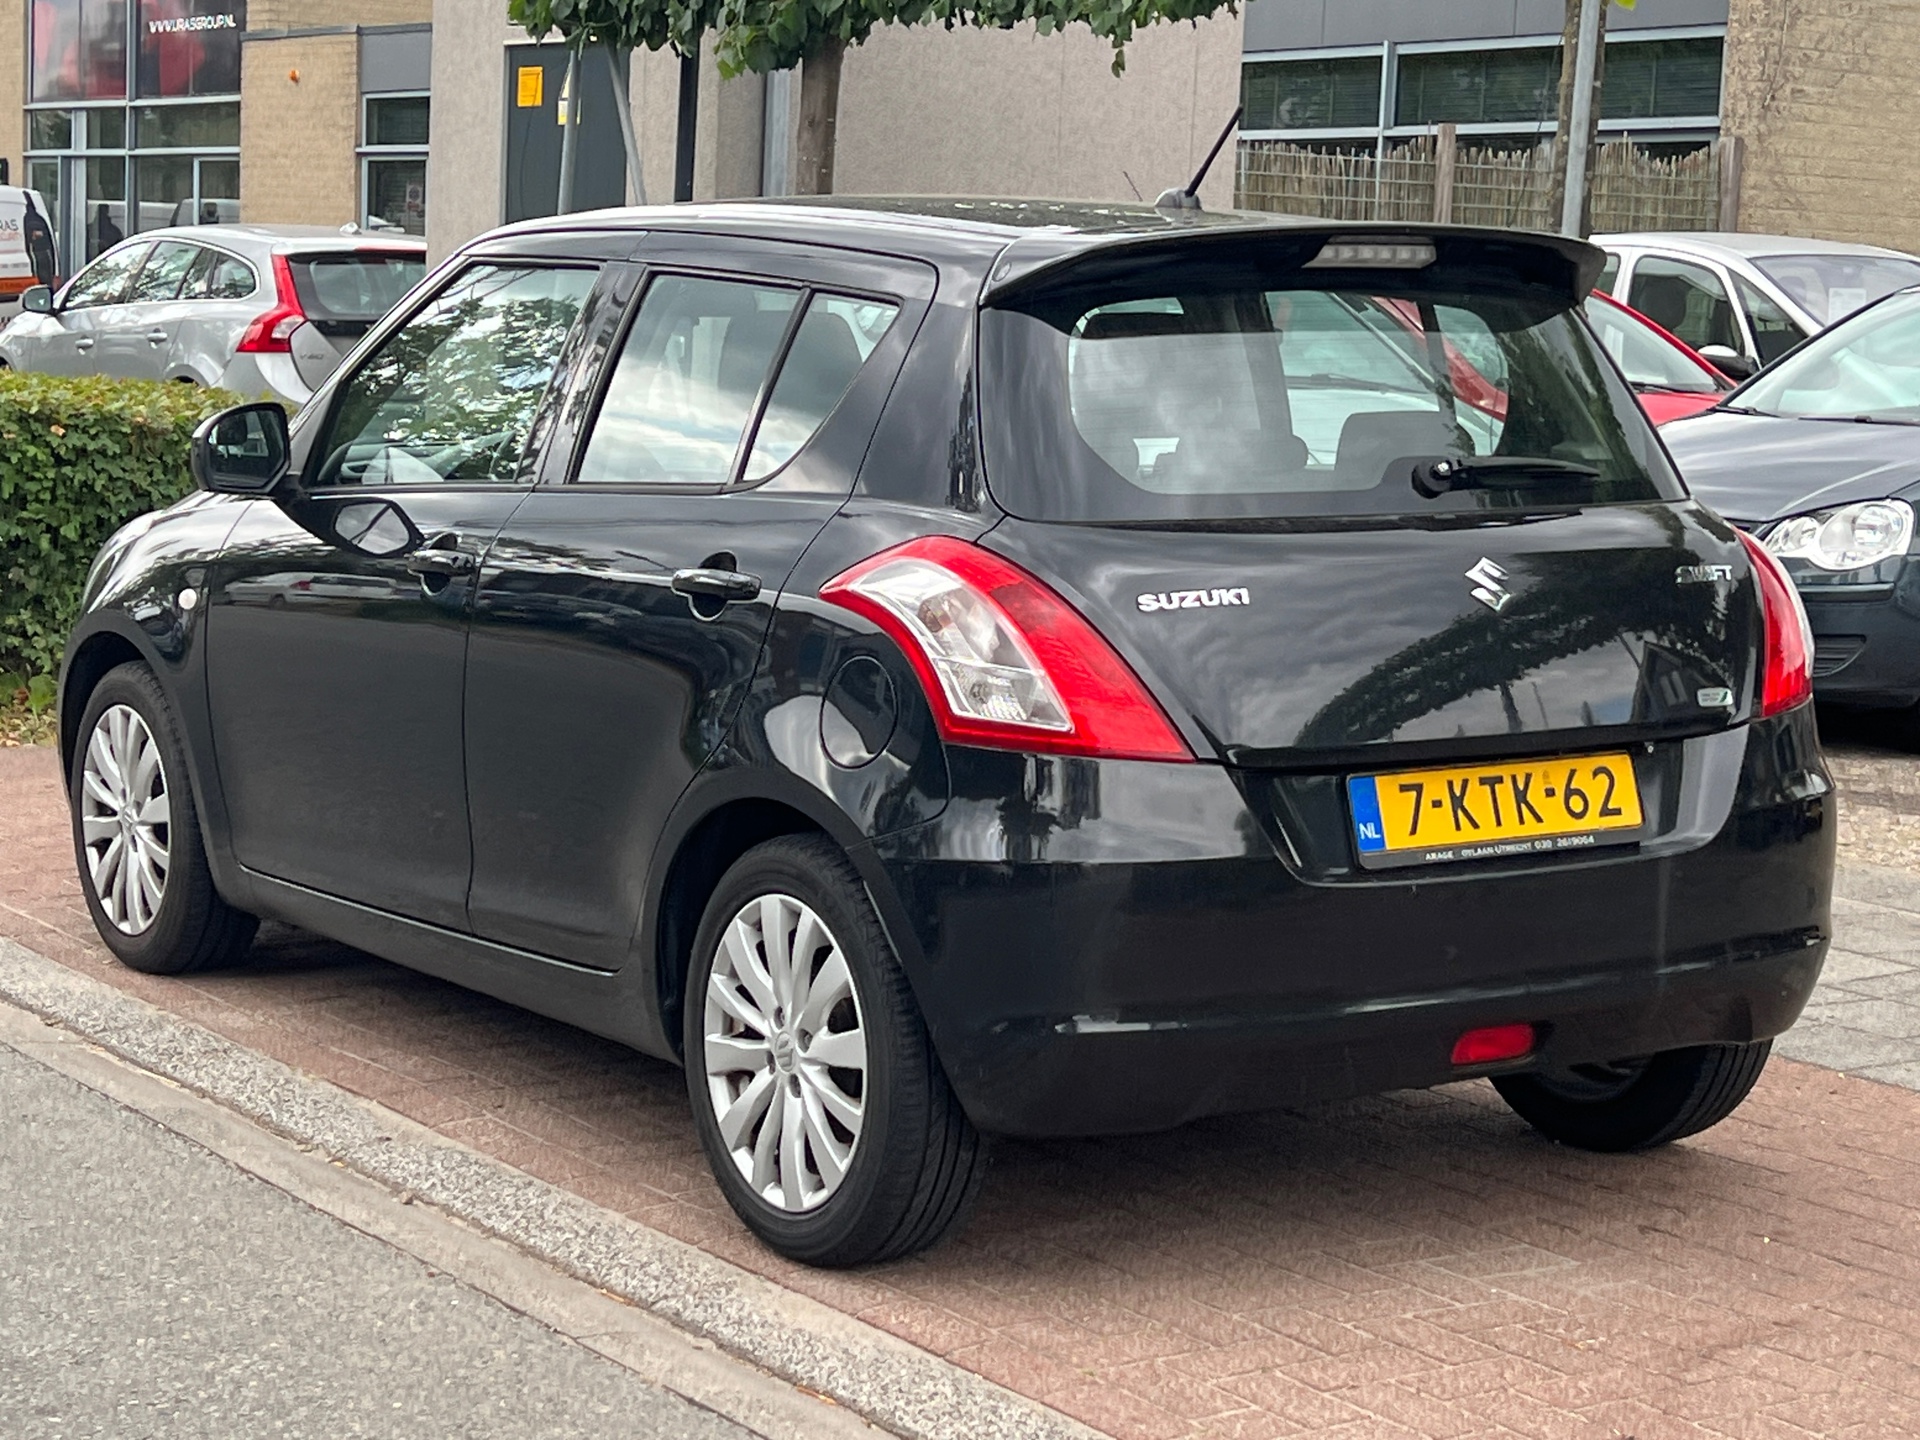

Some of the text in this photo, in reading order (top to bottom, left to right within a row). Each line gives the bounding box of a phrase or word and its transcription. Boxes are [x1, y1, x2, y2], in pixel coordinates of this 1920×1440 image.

[1675, 564, 1733, 584] SWIFT
[1136, 587, 1250, 613] SUZUKI
[1399, 766, 1622, 836] 7-KTK-62
[1358, 821, 1382, 840] NL
